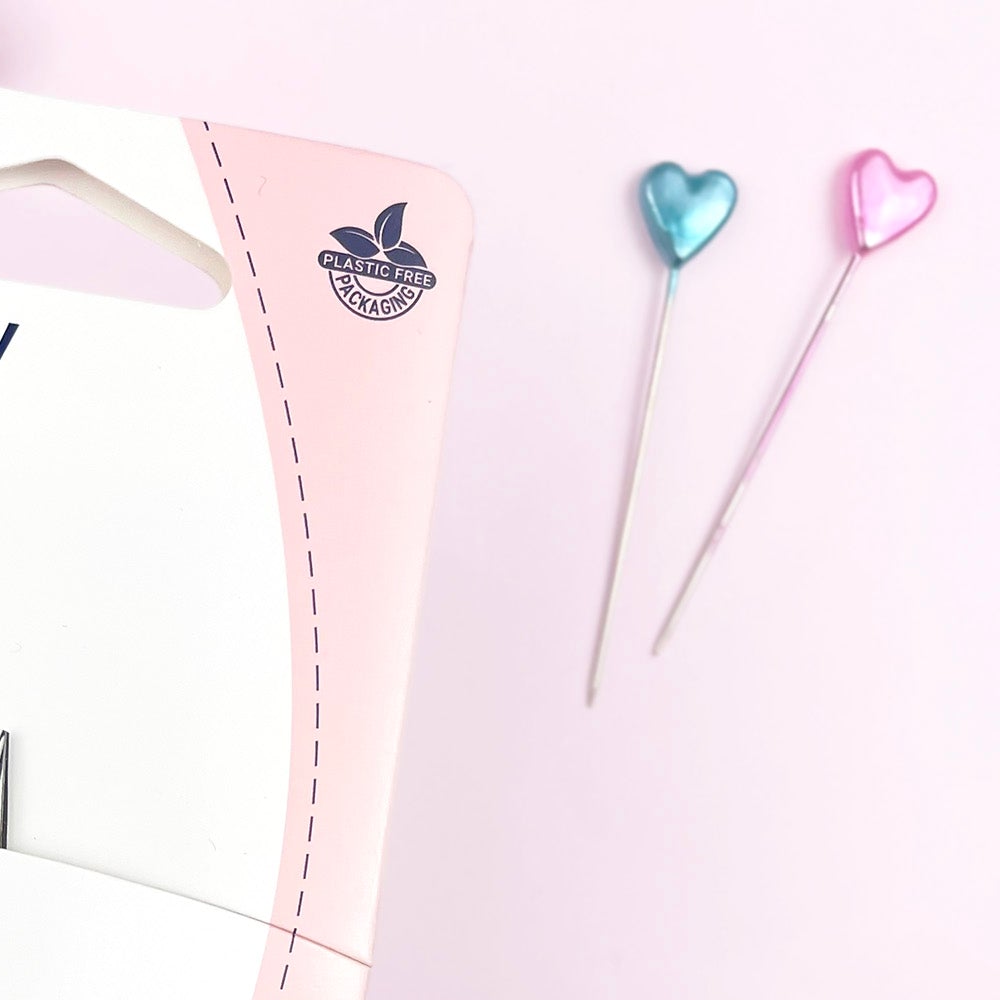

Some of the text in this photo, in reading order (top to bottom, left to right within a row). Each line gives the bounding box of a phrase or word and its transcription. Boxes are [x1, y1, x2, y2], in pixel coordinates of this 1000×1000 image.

[323, 254, 433, 286] PLASTIC FREE
[335, 274, 415, 315] PACKAGING
